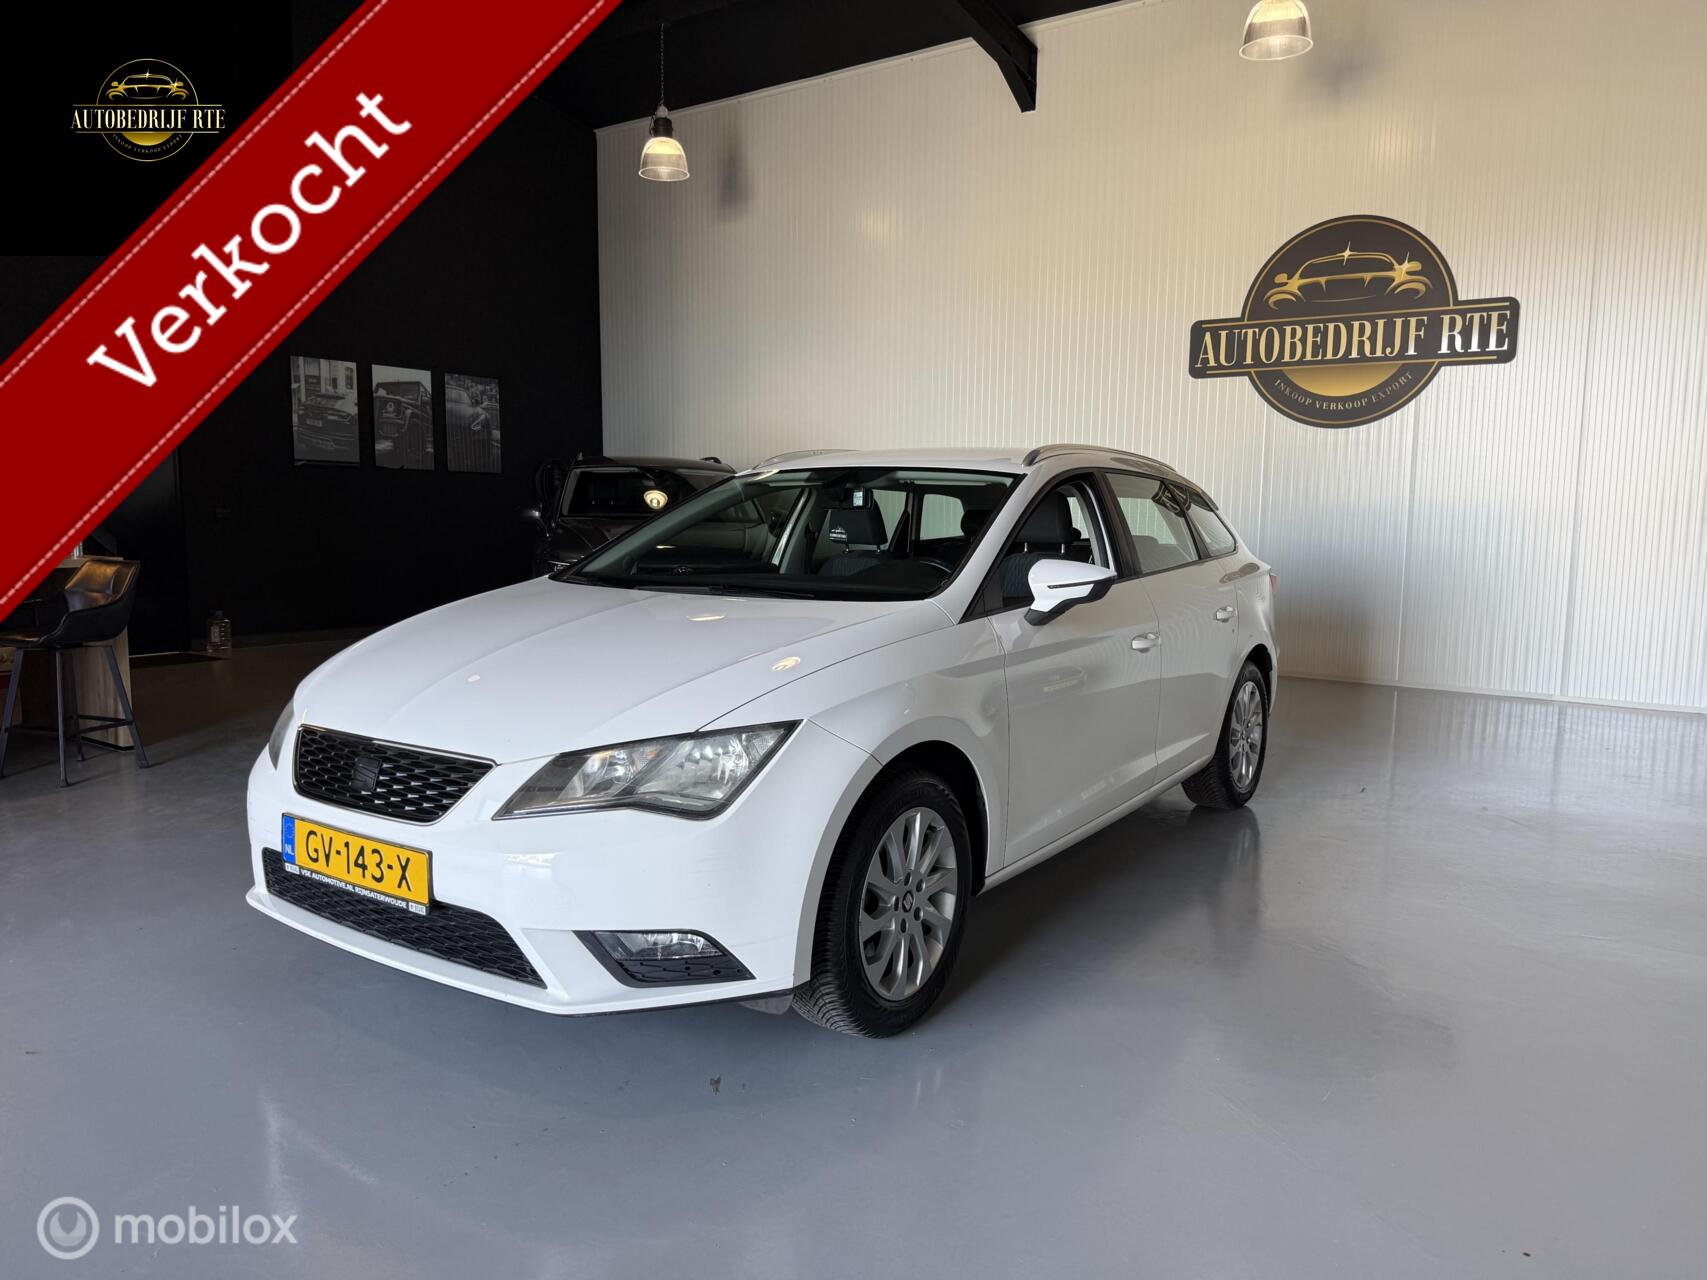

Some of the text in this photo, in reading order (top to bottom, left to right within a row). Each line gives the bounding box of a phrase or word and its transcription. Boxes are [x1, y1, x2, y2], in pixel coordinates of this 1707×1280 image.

[1194, 309, 1511, 368] AUTOBEDRIJF RTE
[1273, 371, 1414, 411] INKOOP VERKOOP EXPORT
[284, 843, 295, 856] NL
[305, 829, 413, 892] GV-143-X
